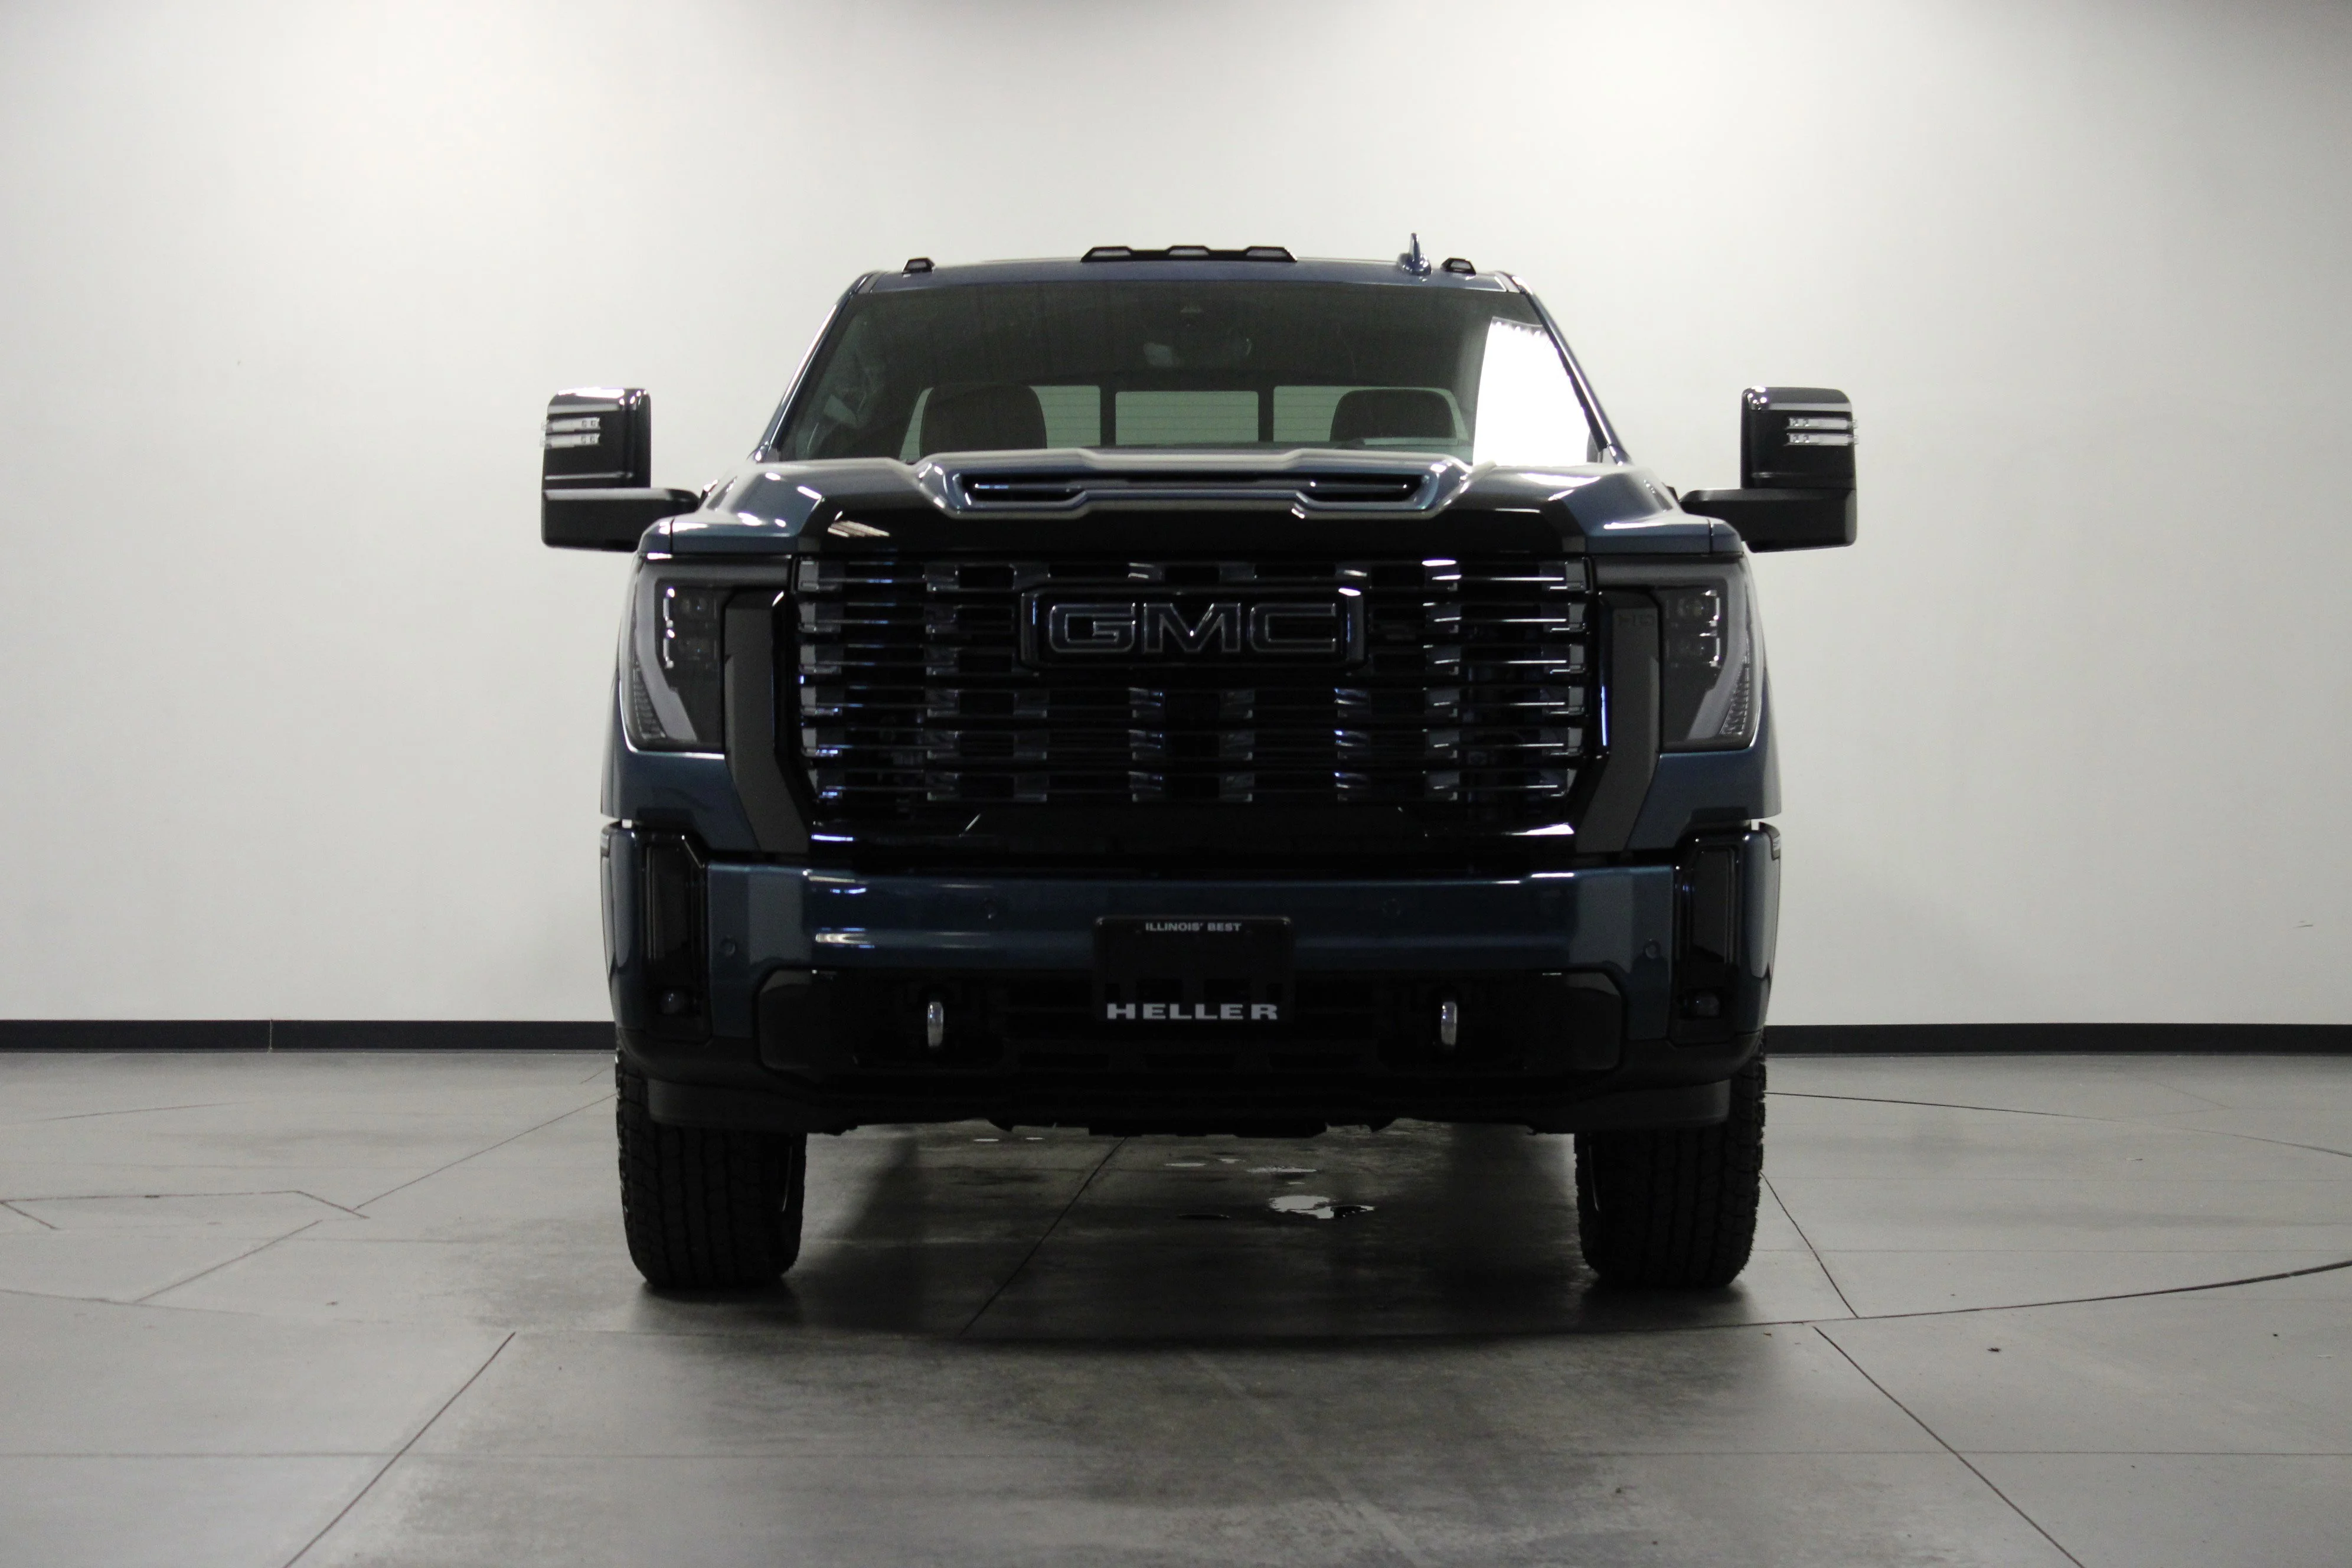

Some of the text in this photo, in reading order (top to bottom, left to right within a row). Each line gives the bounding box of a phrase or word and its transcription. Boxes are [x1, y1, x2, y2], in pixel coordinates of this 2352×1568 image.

[1048, 602, 1337, 653] GMC
[1207, 922, 1242, 932] BEST
[1106, 1002, 1278, 1020] HELLER
